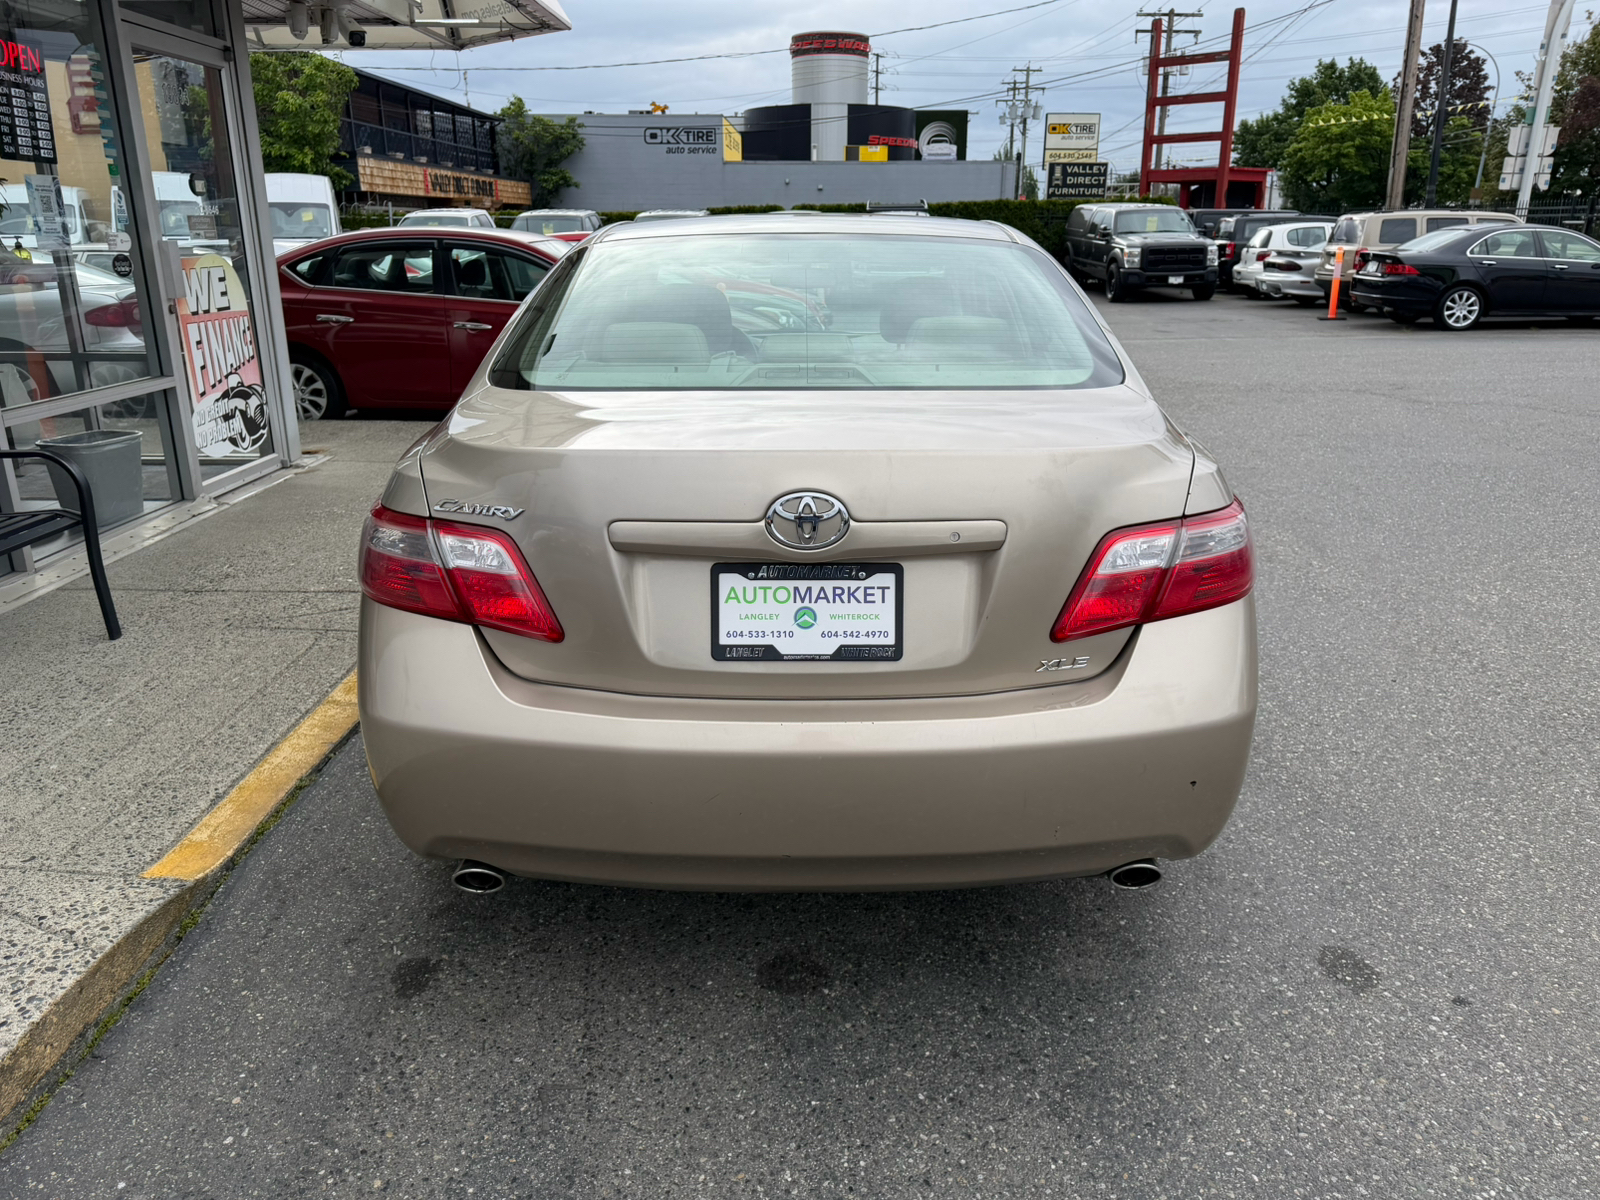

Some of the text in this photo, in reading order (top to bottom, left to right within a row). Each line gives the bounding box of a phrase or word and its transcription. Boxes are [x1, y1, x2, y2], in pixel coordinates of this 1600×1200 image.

[0, 38, 43, 74] OPEN
[23, 76, 45, 89] HOURS
[0, 115, 11, 124] THU
[1, 125, 10, 133] FRI
[1074, 125, 1094, 133] TIRE
[2, 135, 12, 143] SAT
[683, 130, 714, 142] TIRE
[4, 145, 15, 153] SUN
[687, 146, 717, 154] service
[1066, 165, 1106, 174] VALLEY
[1066, 176, 1105, 185] DIRECT
[1049, 187, 1105, 195] FURNITURE
[182, 266, 230, 316] WE
[186, 314, 254, 397] FINANCE
[197, 409, 206, 427] NO
[197, 430, 207, 449] NO
[433, 498, 525, 521] CAMRY
[757, 565, 860, 579] AUTOMARKET
[724, 586, 891, 604] AUTOMARKET
[726, 630, 794, 638] 604-533-1310
[820, 630, 889, 638] 604-542-4970
[725, 647, 765, 657] LANGLEY
[1035, 656, 1090, 672] XLE
